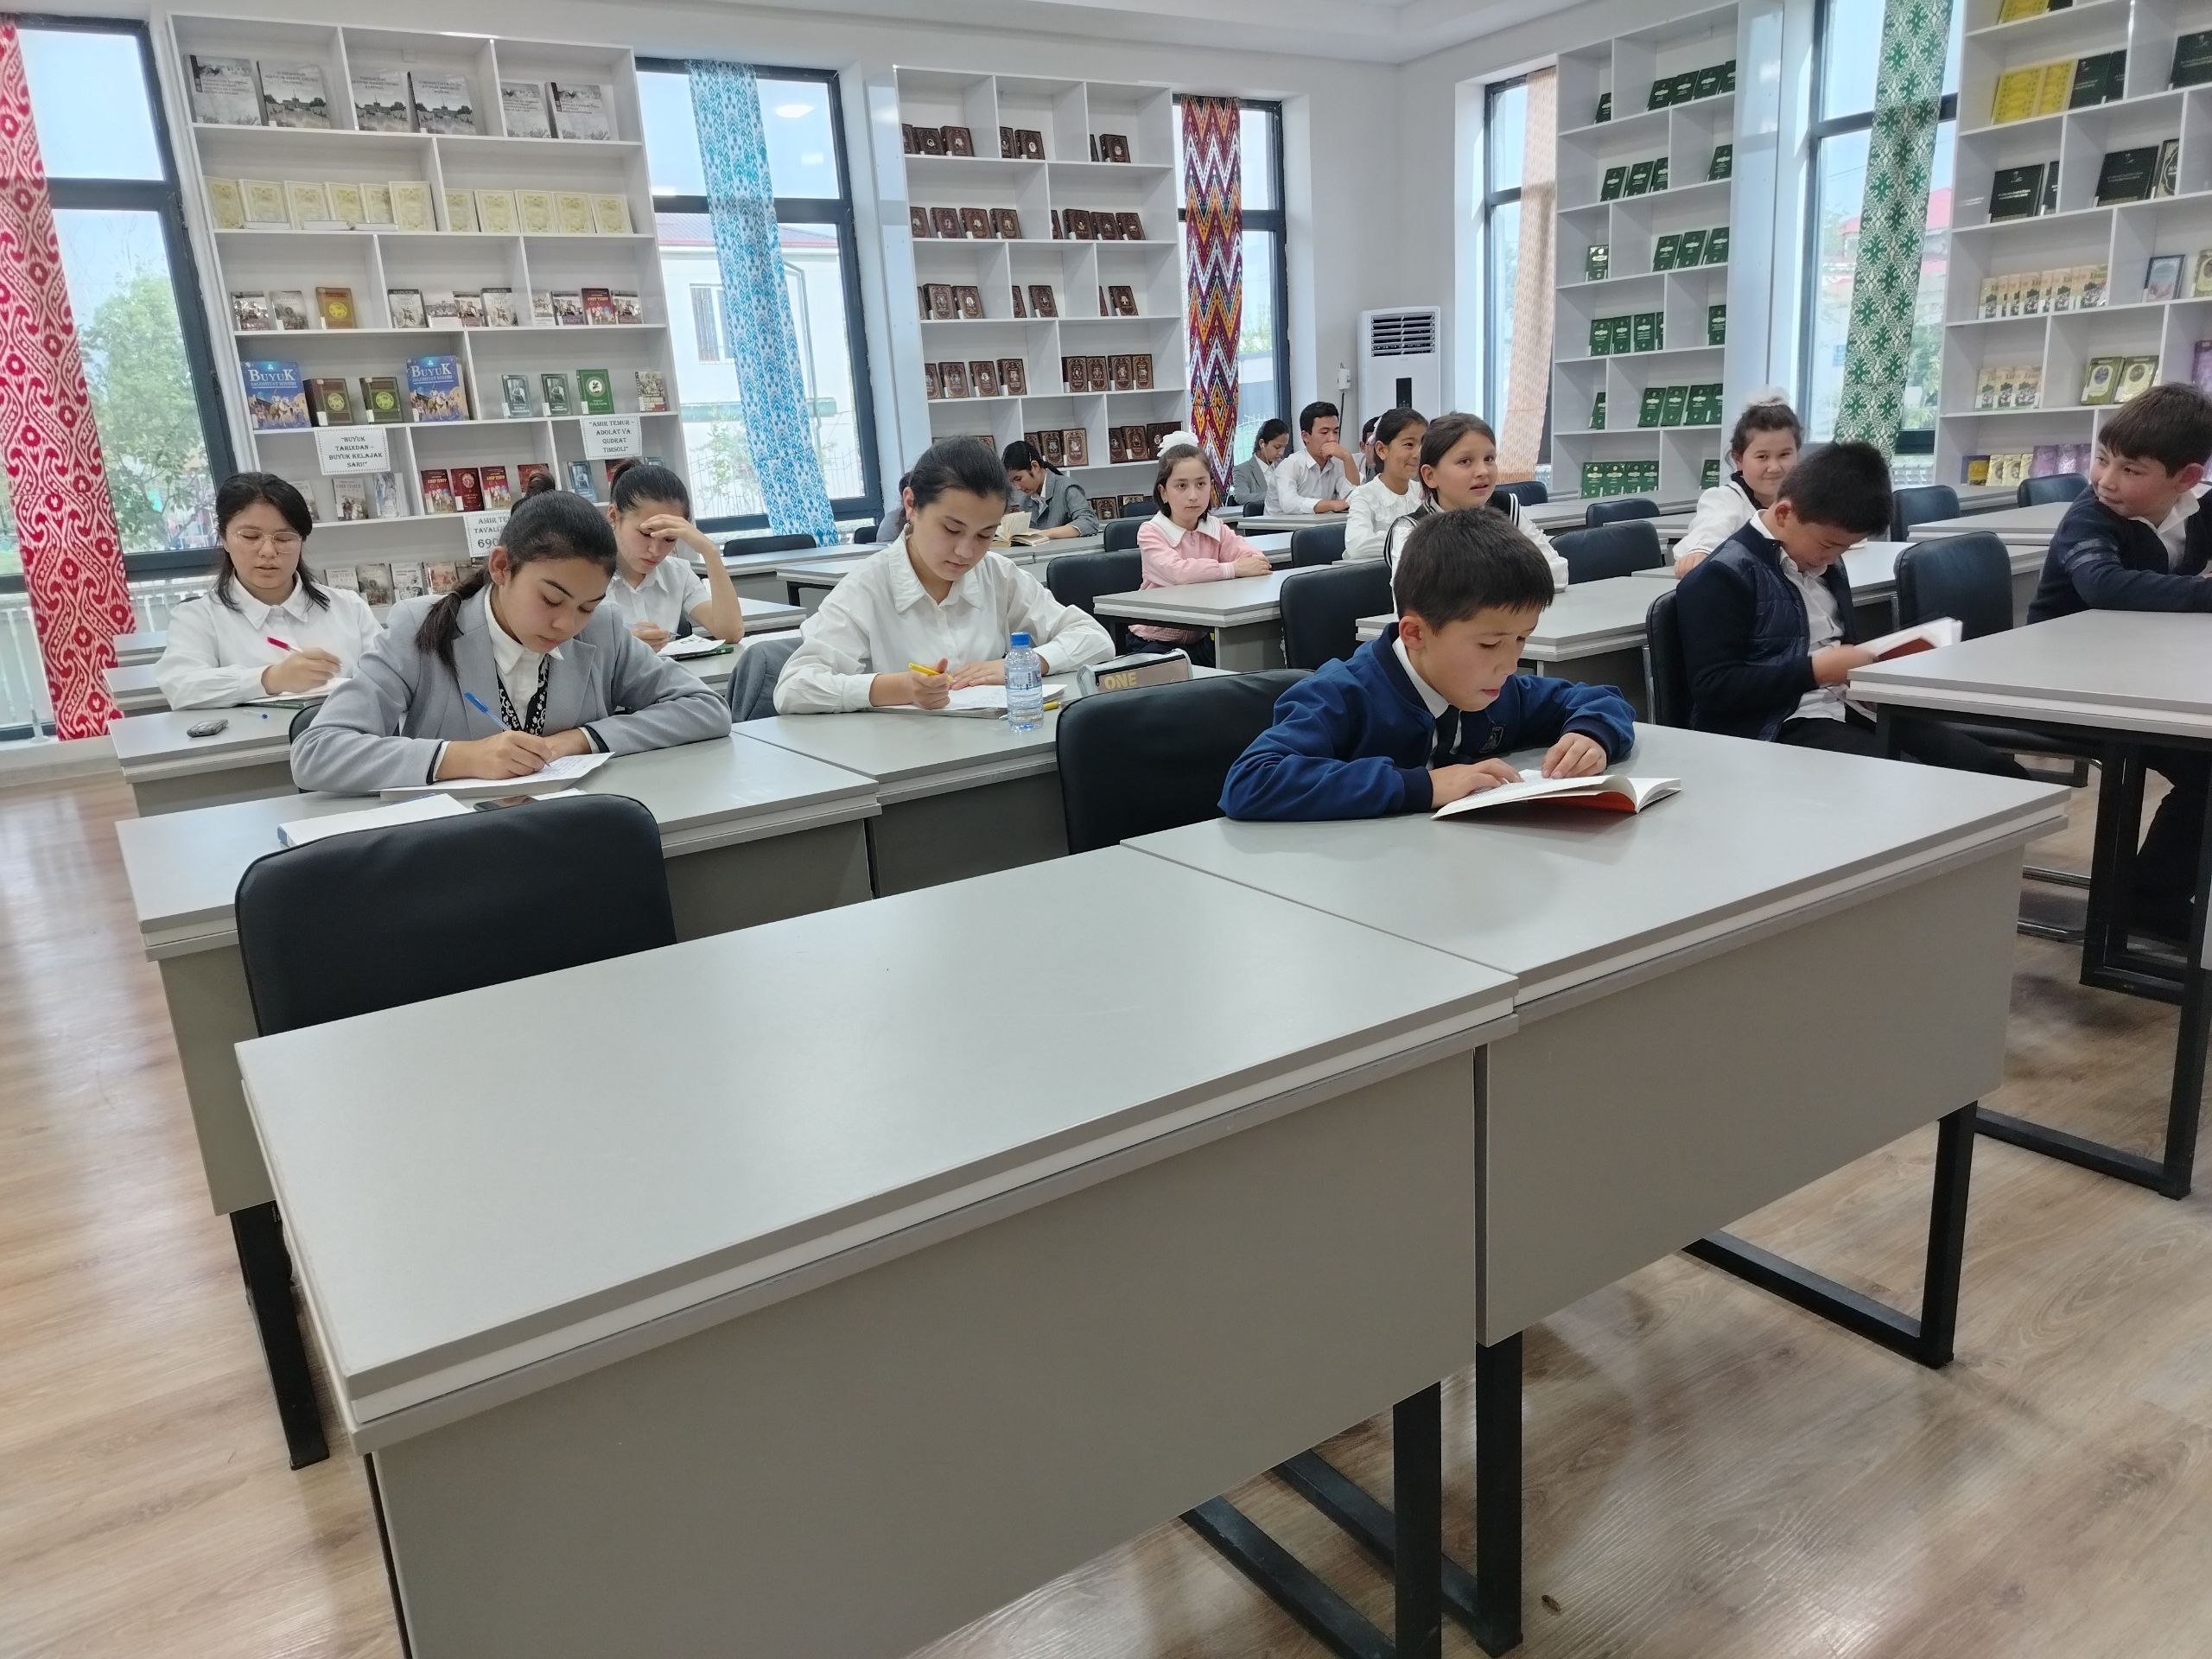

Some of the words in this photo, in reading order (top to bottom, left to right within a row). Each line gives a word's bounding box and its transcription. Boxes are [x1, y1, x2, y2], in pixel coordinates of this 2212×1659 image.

[248, 369, 296, 382] BUYUK
[410, 363, 452, 378] BUYUK
[477, 537, 499, 550] 690
[1104, 671, 1137, 690] ONE
